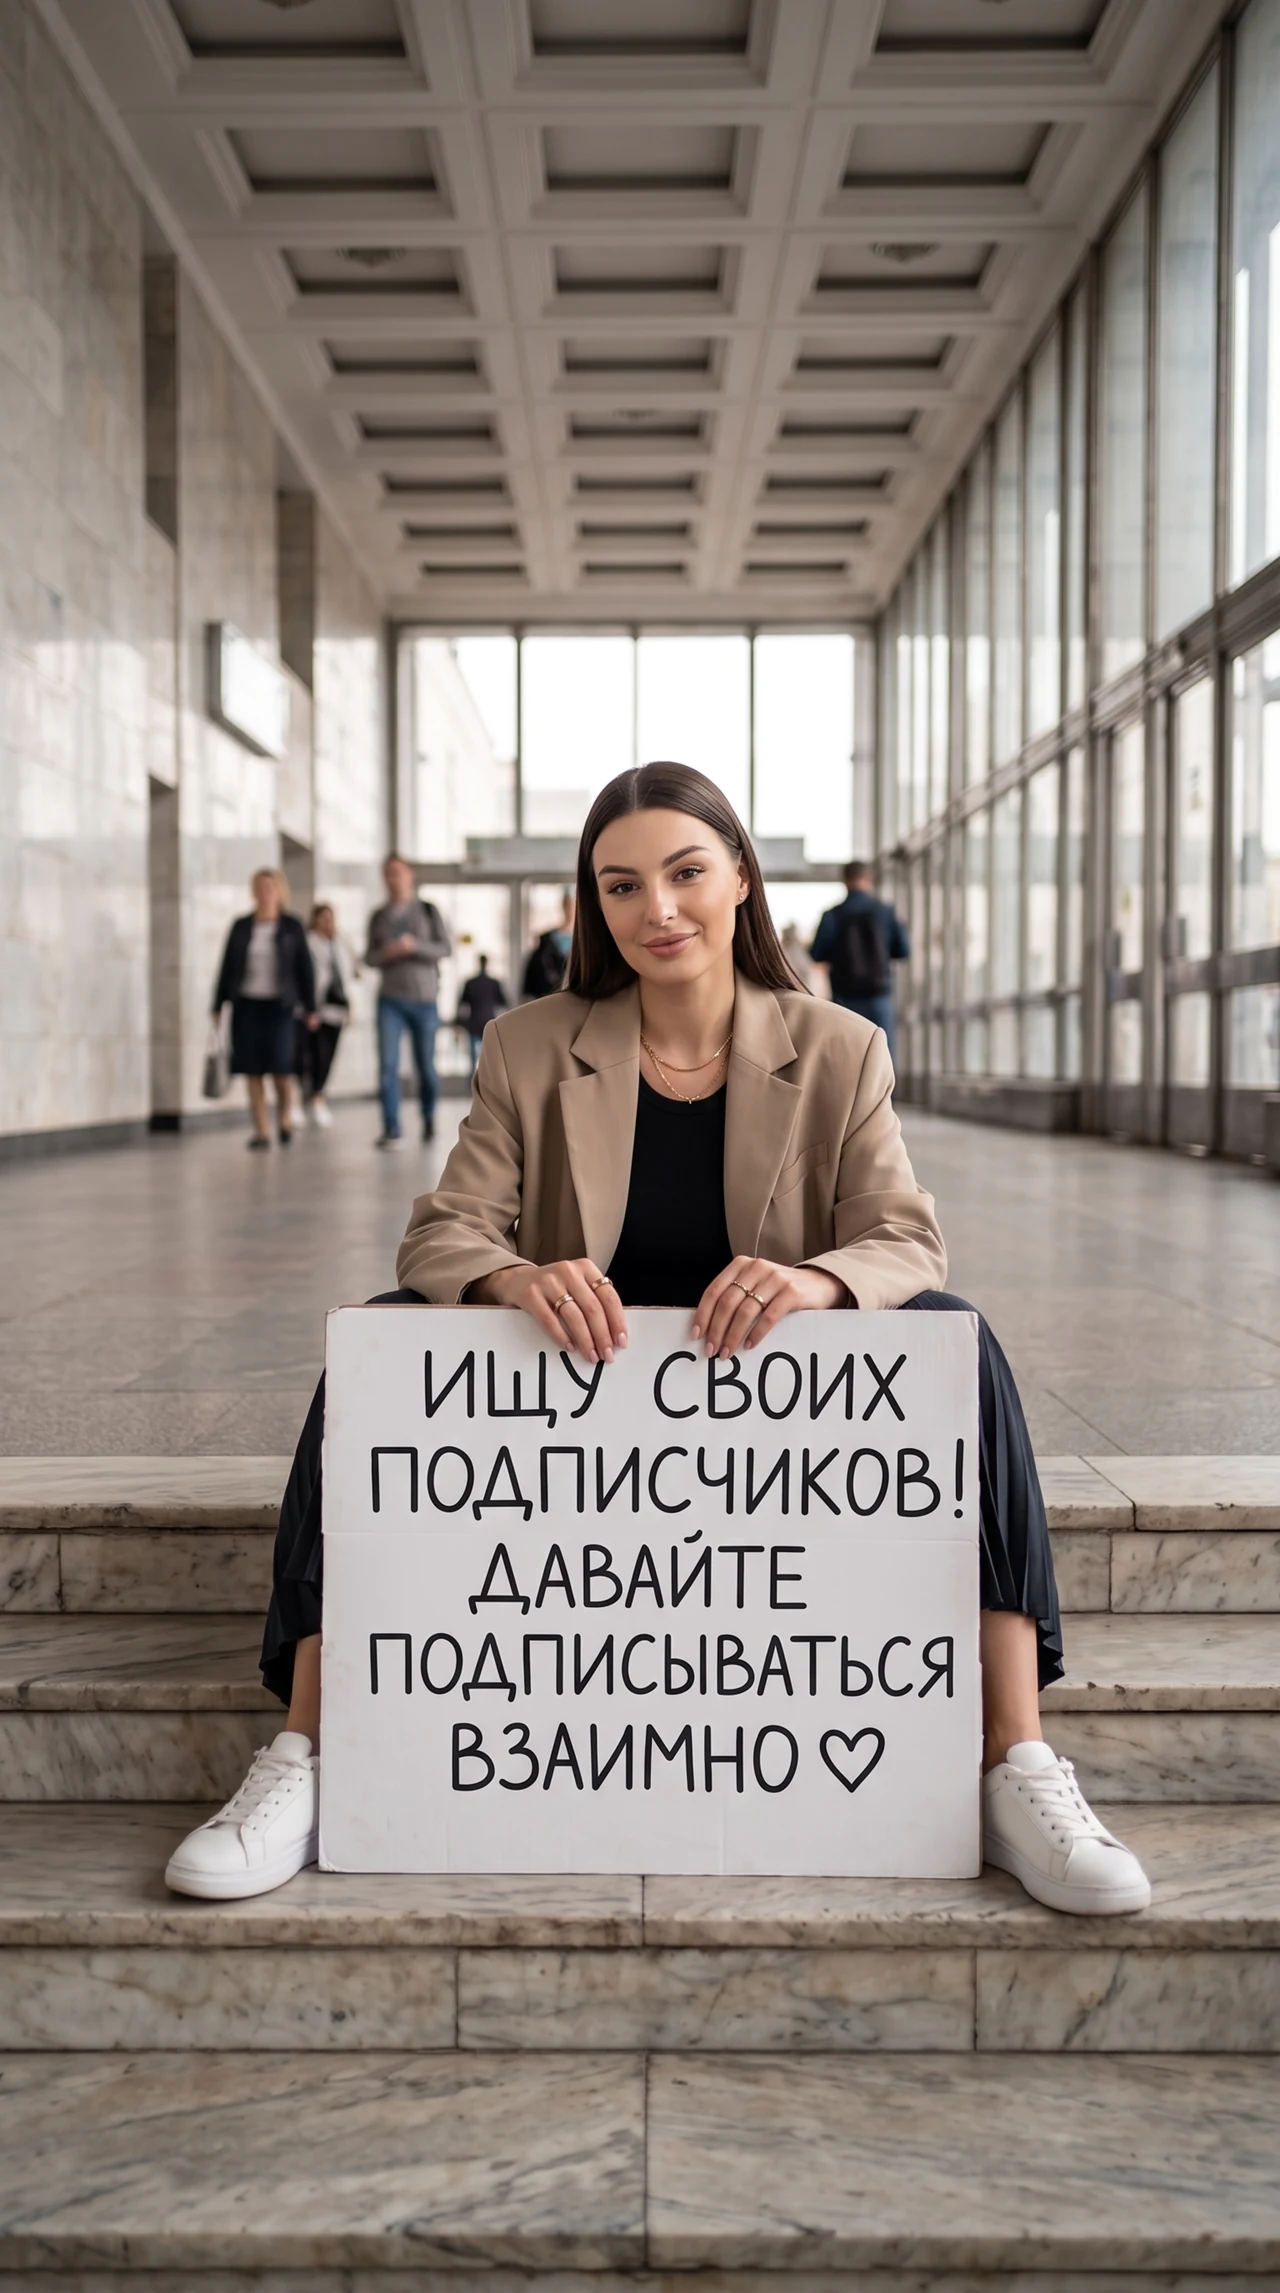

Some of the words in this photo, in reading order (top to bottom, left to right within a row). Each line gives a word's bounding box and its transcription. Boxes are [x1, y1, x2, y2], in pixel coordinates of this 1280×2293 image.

[424, 1349, 606, 1428] ИЩУ
[653, 1350, 907, 1421] СВОИХ
[370, 1438, 965, 1521] ПОДПИСЧИКОВ!
[468, 1529, 808, 1616] ДАВАЙТЕ
[369, 1632, 954, 1703] ПОДПИСЫВАТЬСЯ
[451, 1722, 799, 1794] ВЗАИМНО
